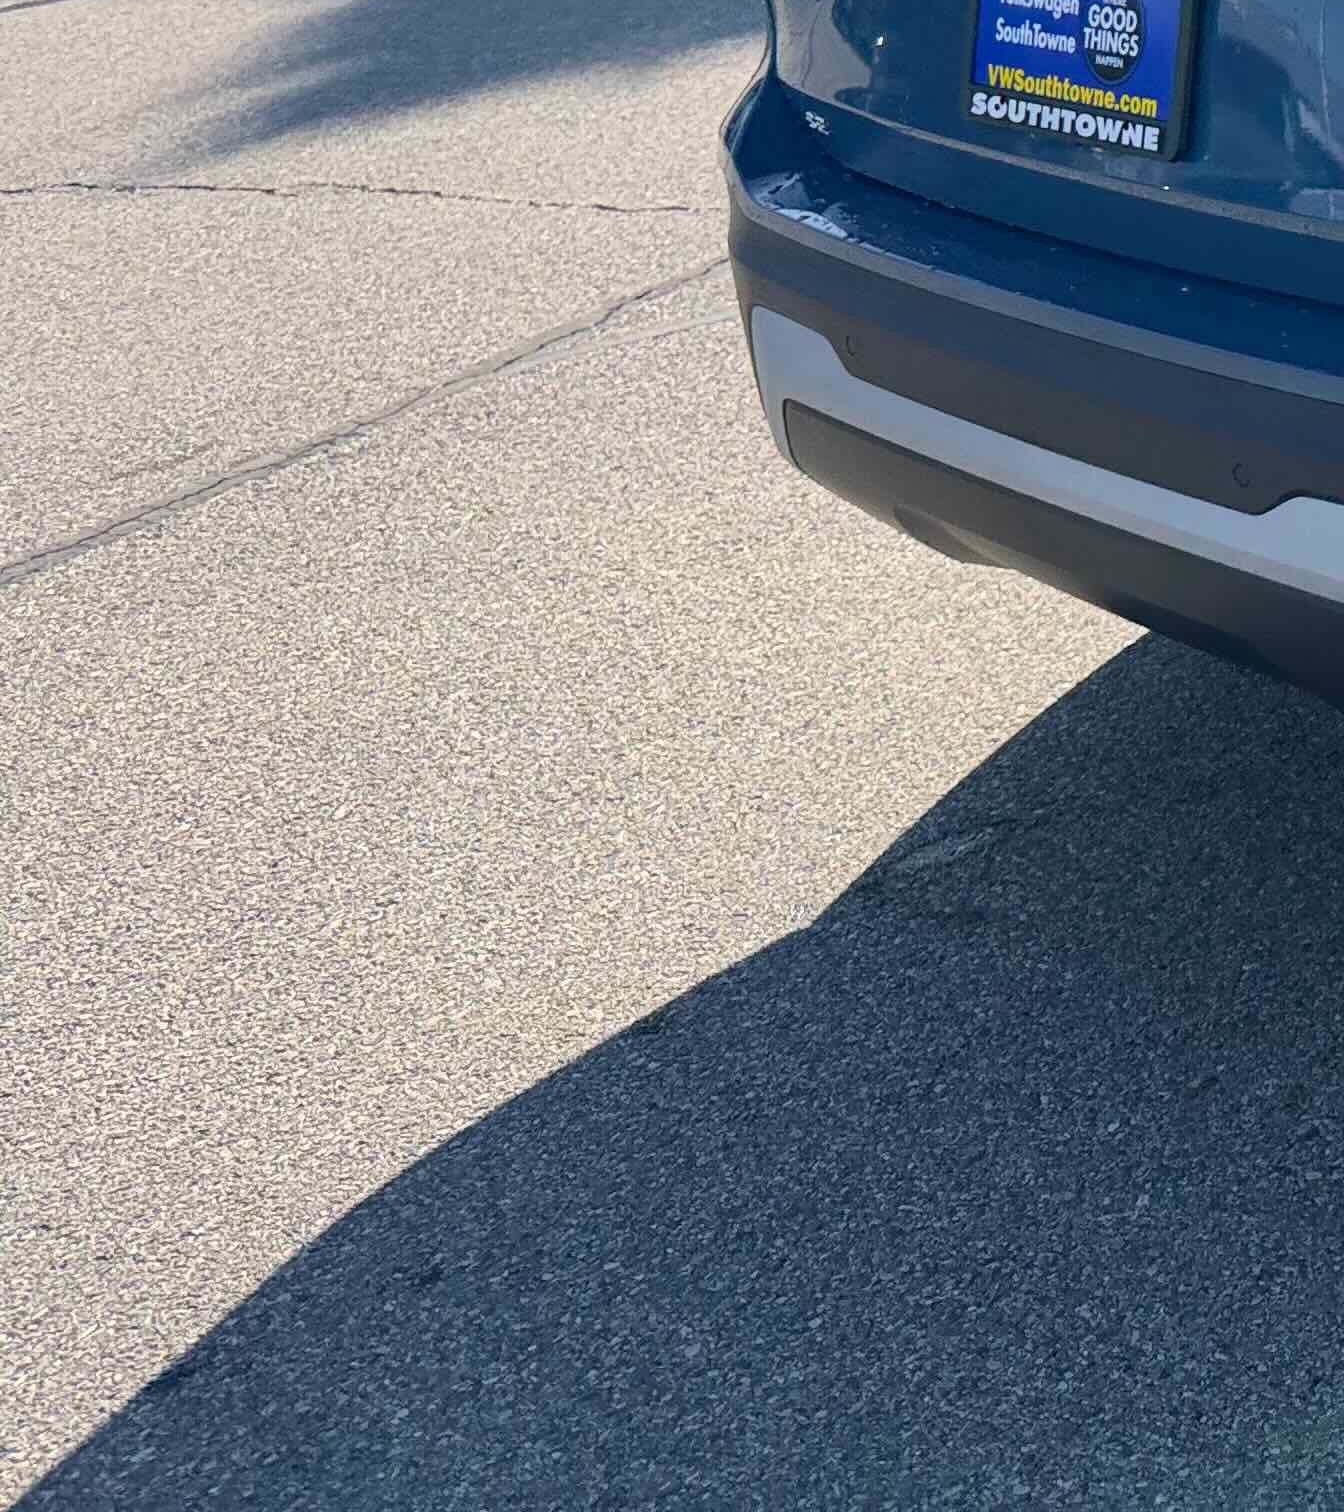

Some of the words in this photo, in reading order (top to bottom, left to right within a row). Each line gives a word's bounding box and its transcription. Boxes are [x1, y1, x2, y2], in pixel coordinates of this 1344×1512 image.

[995, 17, 1077, 55] SouthTowne
[1087, 3, 1138, 33] GOOD
[1083, 27, 1140, 57] THINGS
[987, 63, 1158, 118] VWSouthtowne.com
[970, 92, 1160, 152] SOUTHTOWNE
